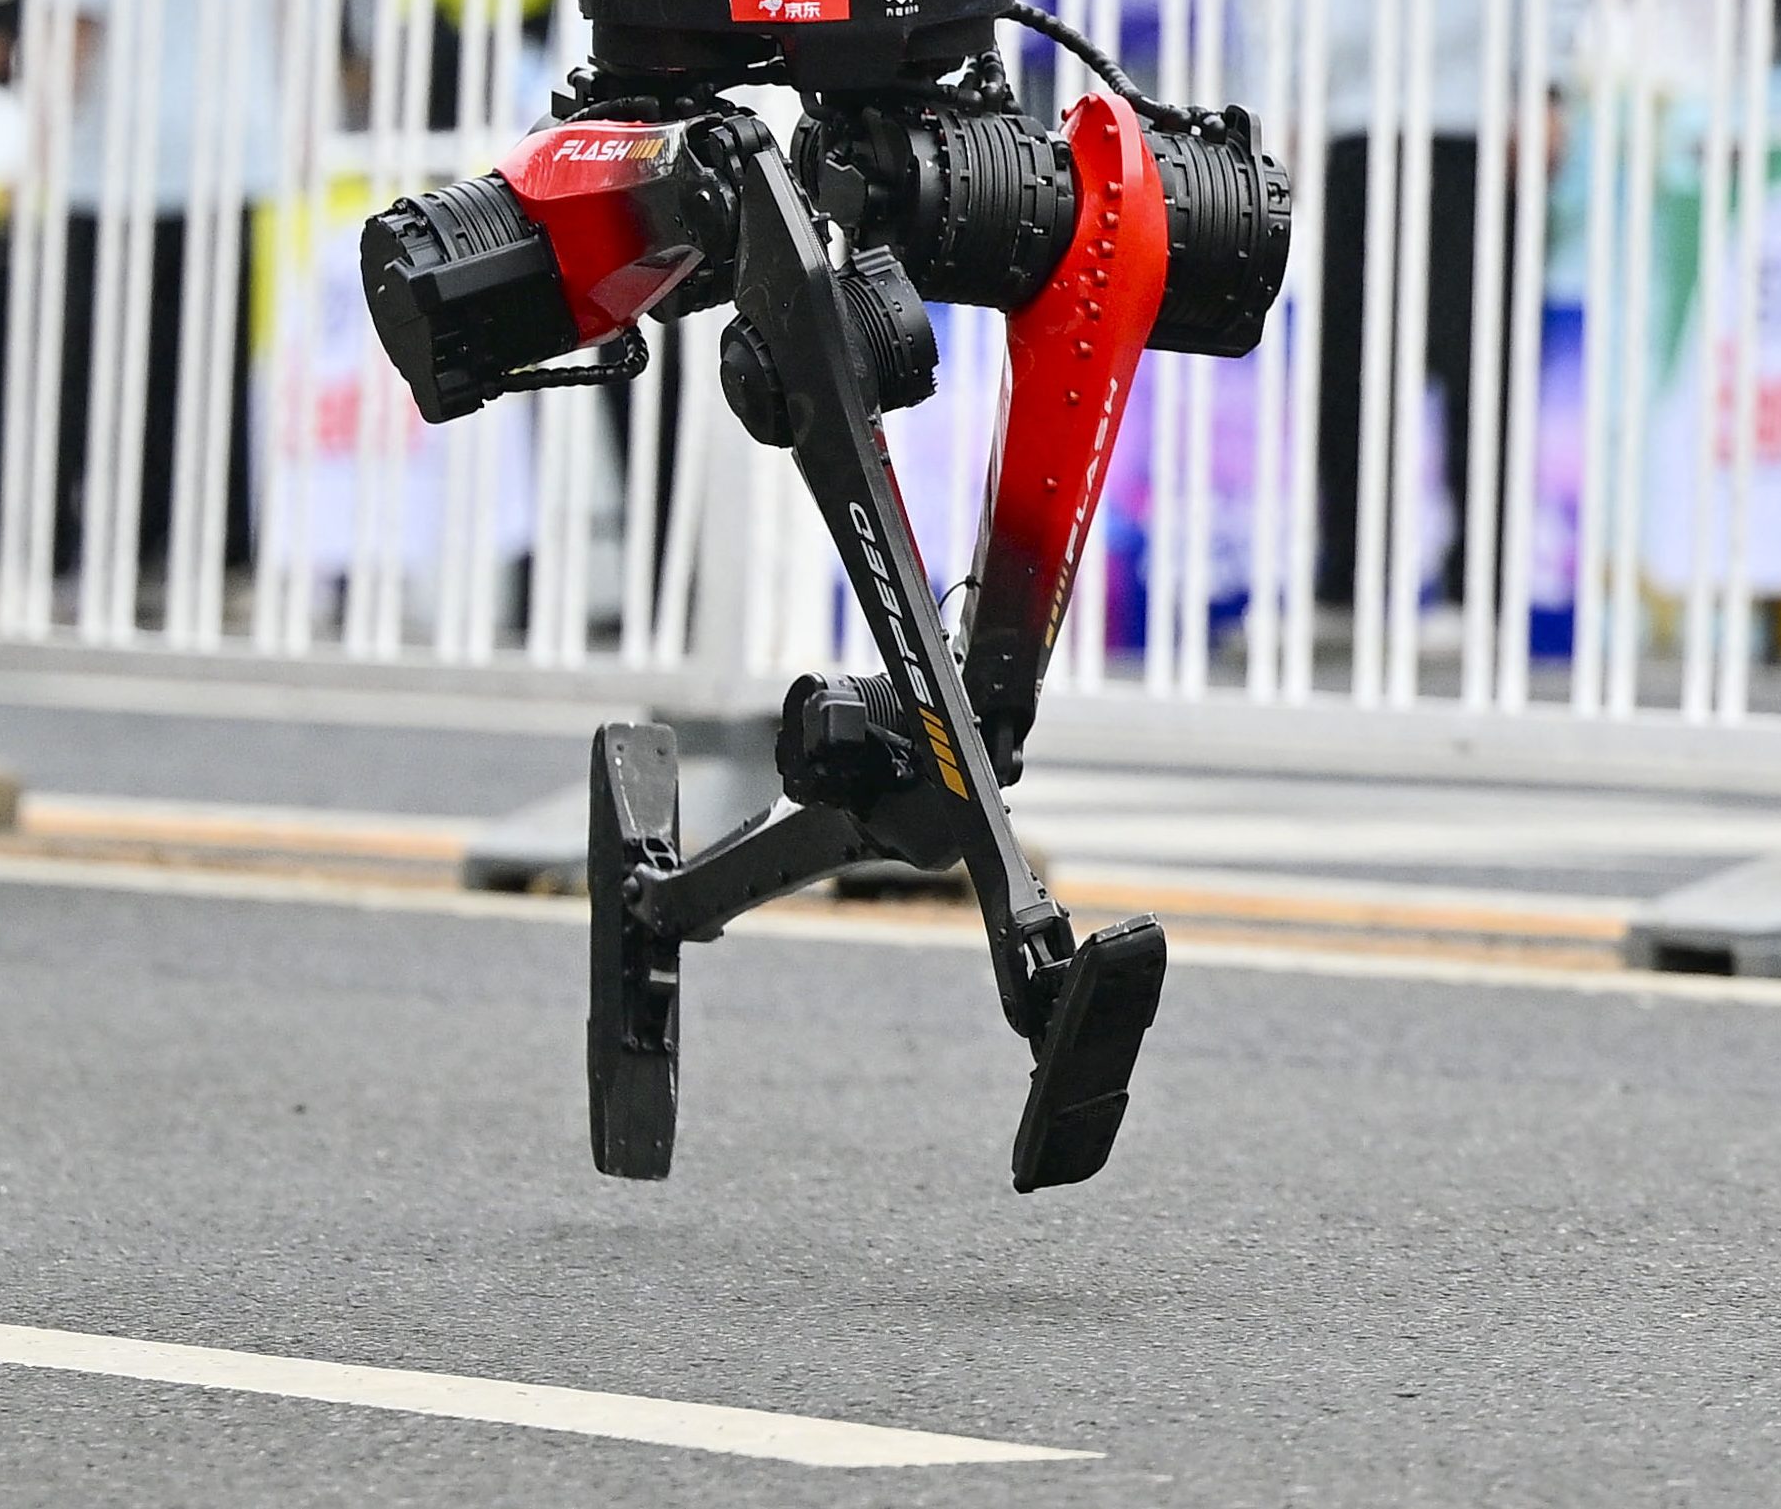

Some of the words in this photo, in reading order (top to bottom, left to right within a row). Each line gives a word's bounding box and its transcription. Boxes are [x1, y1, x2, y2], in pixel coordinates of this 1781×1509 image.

[784, 1, 821, 19] 京东
[553, 138, 633, 162] FLASH
[1065, 376, 1119, 566] FLASH
[849, 500, 935, 710] SPEED
